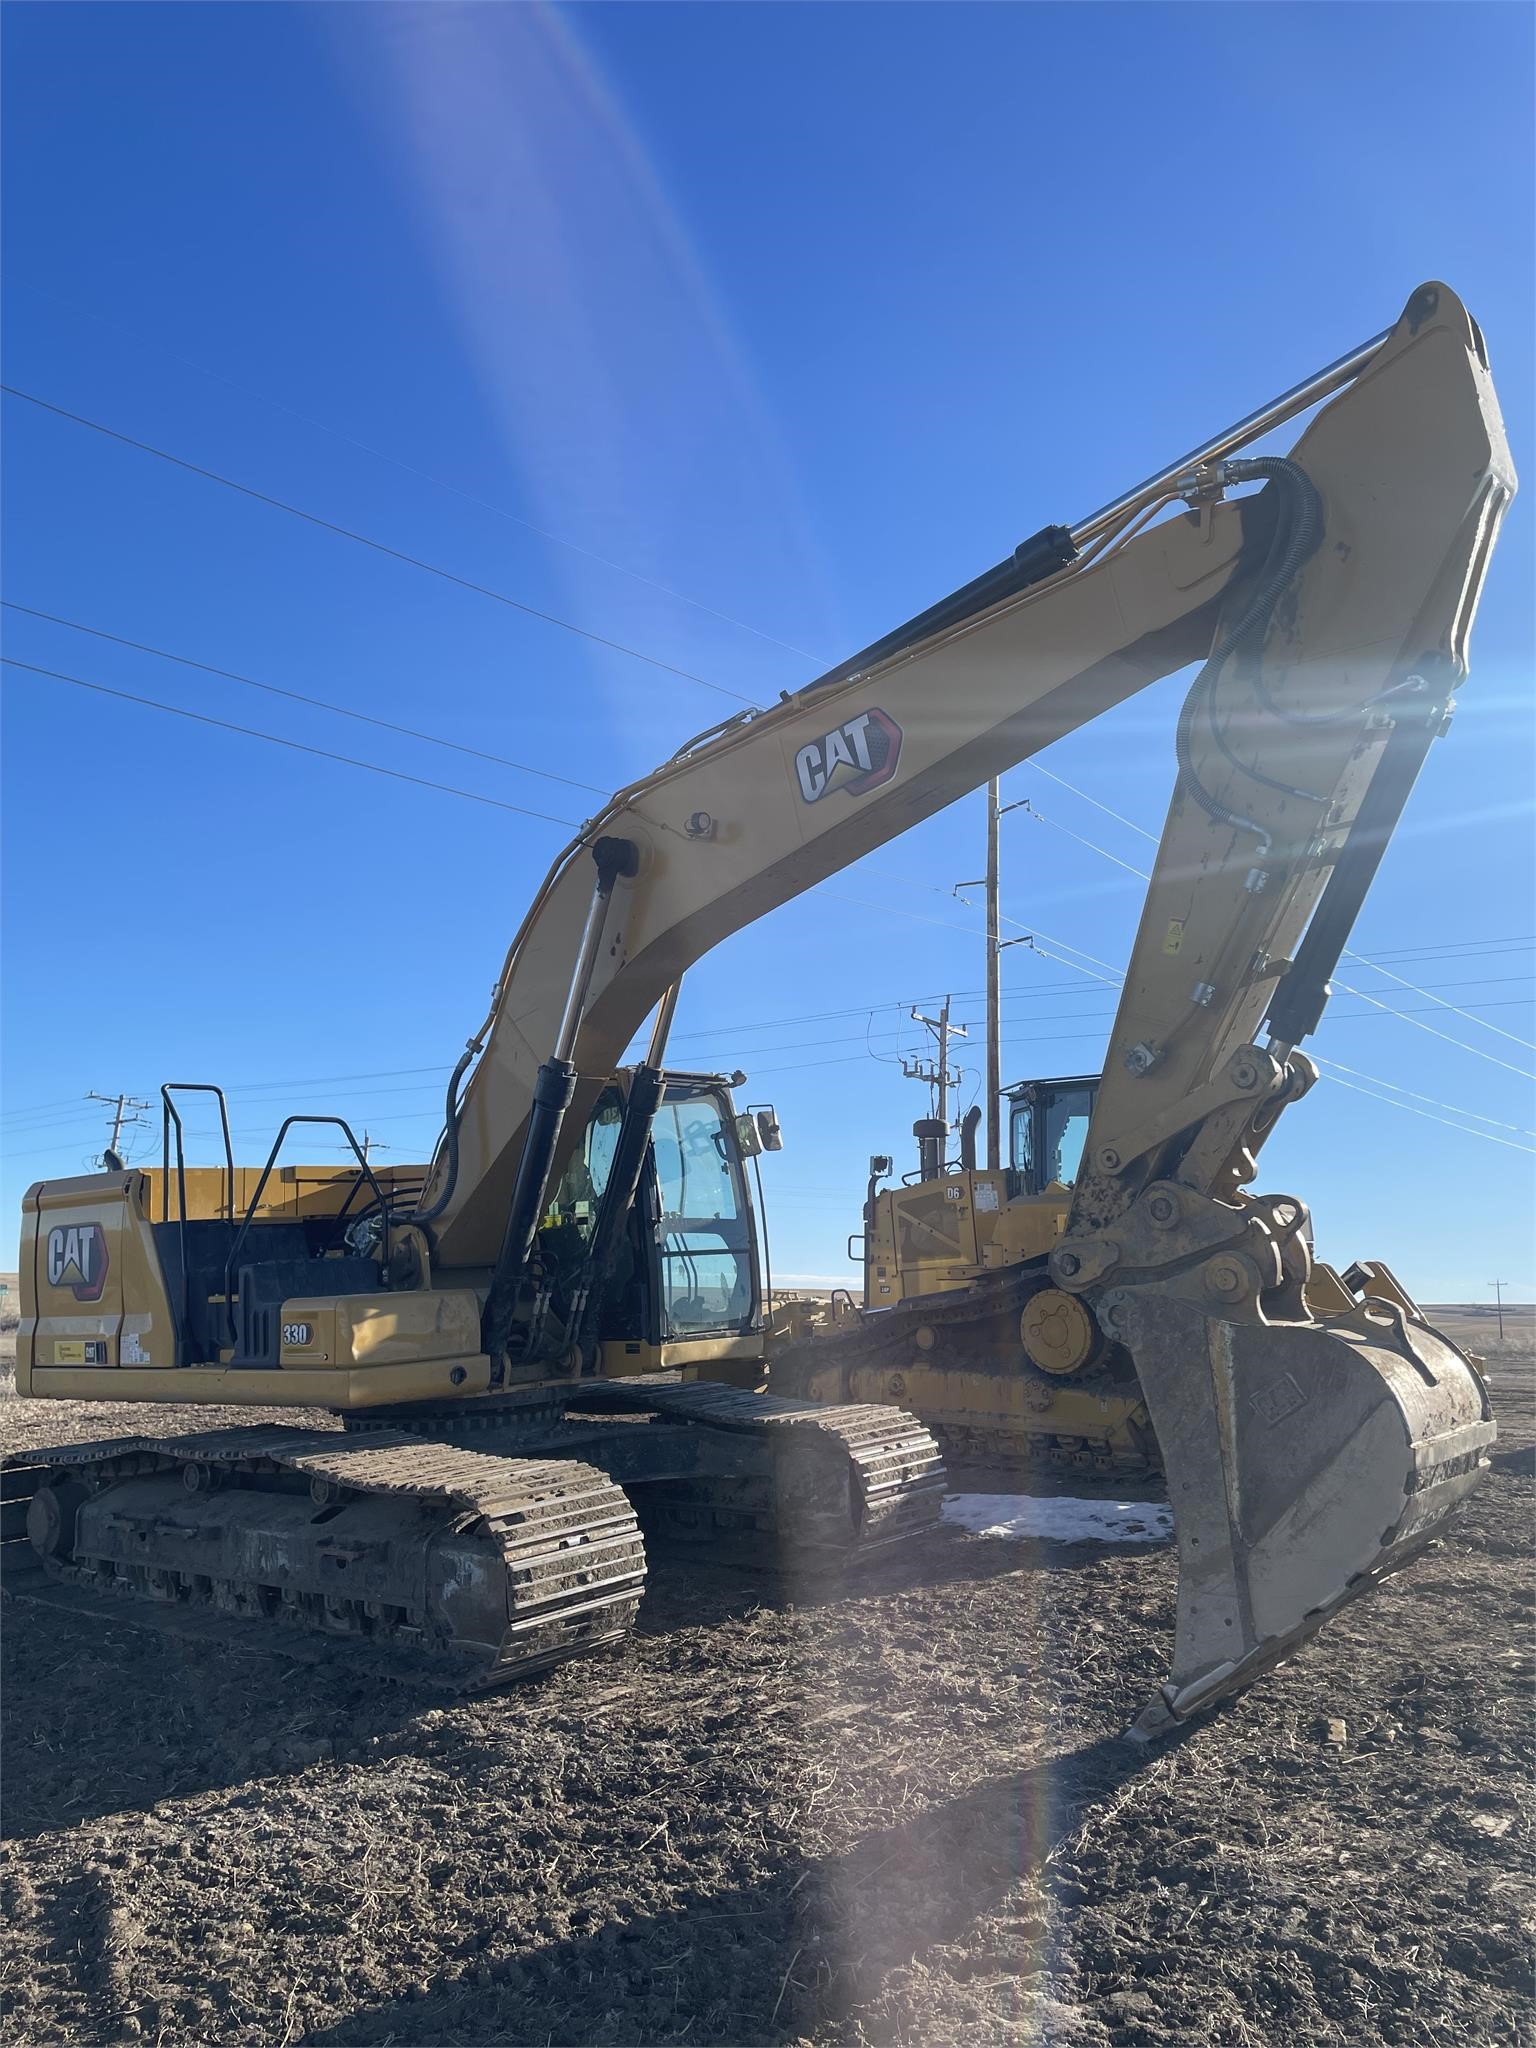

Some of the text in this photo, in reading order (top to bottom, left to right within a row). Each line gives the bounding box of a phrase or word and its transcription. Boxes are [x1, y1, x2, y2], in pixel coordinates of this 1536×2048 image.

[796, 713, 873, 802] CAT
[947, 1187, 960, 1199] D6
[48, 1226, 95, 1285] CAT
[283, 1324, 307, 1344] 330
